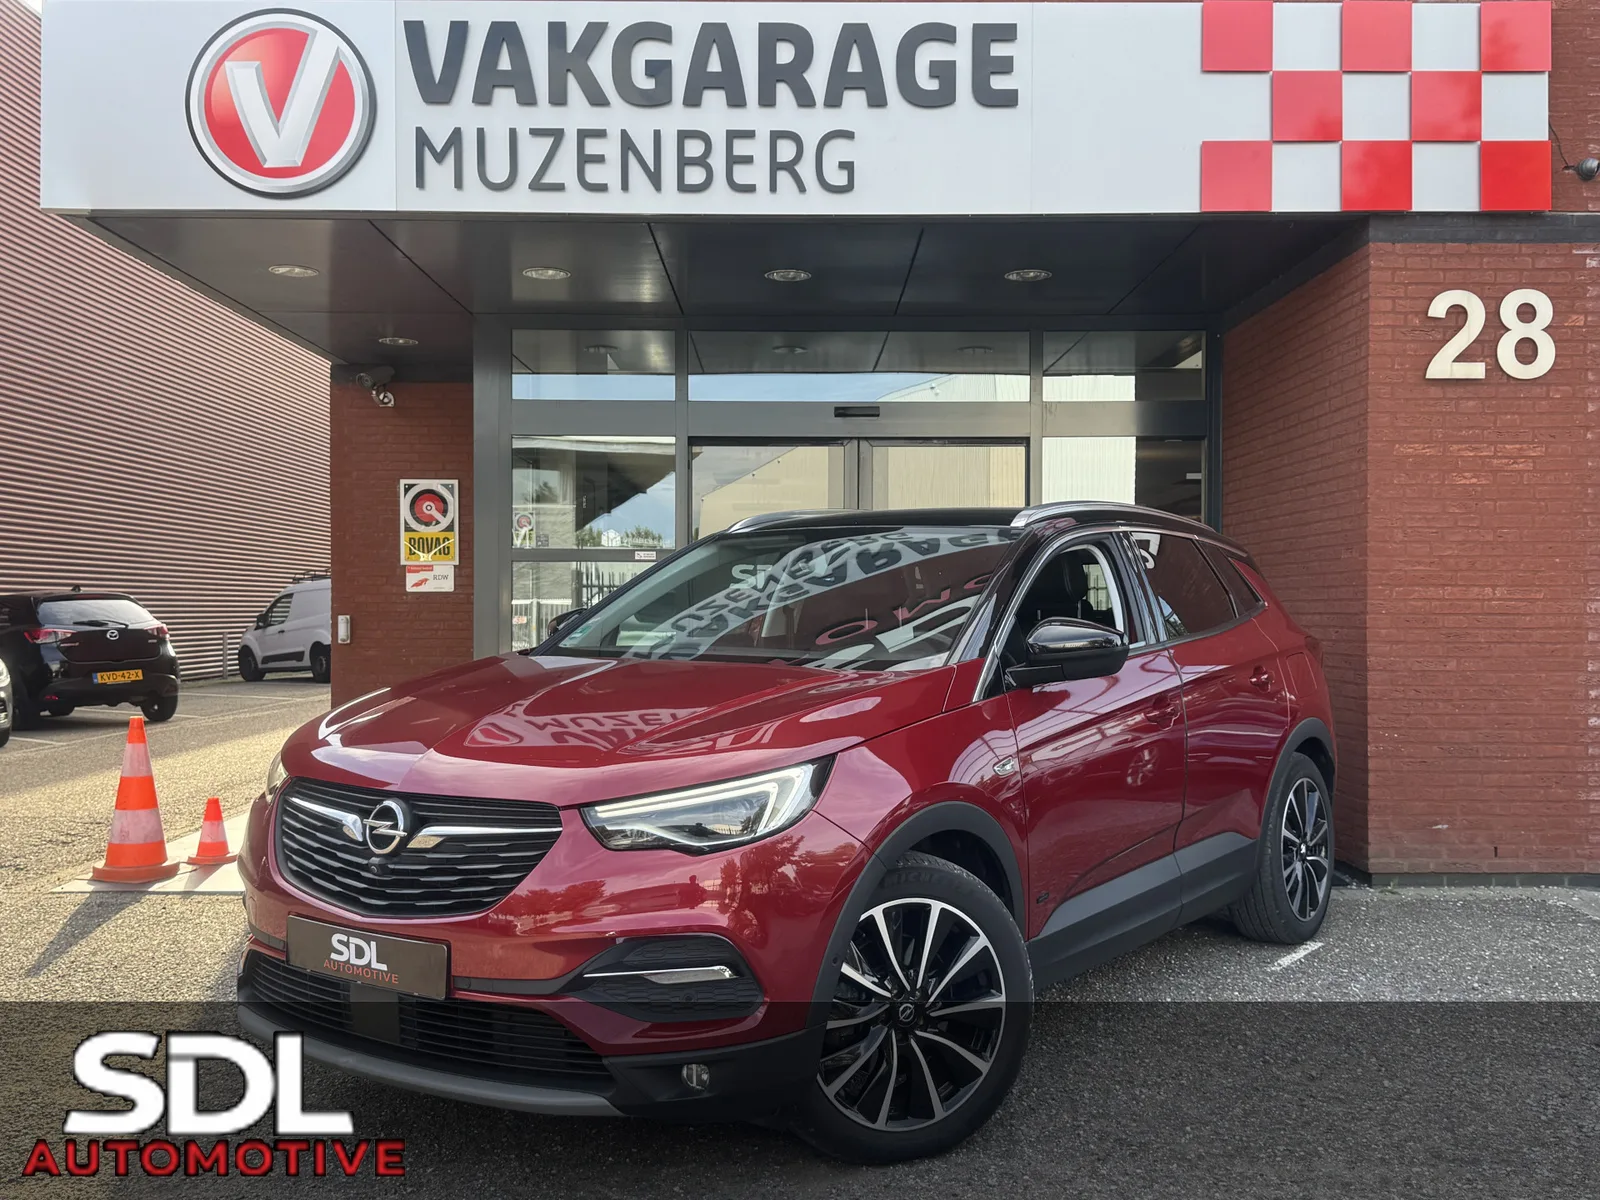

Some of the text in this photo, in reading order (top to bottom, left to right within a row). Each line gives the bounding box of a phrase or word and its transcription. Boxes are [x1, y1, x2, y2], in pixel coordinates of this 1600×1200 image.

[403, 20, 1019, 107] VAKGARAGE
[415, 126, 856, 193] MUZENBERG
[1425, 288, 1556, 380] 28
[408, 537, 451, 556] BOVAG
[100, 670, 140, 682] KVD-42-X
[330, 933, 388, 971] SDL
[323, 959, 399, 984] AUTOMOTIVE
